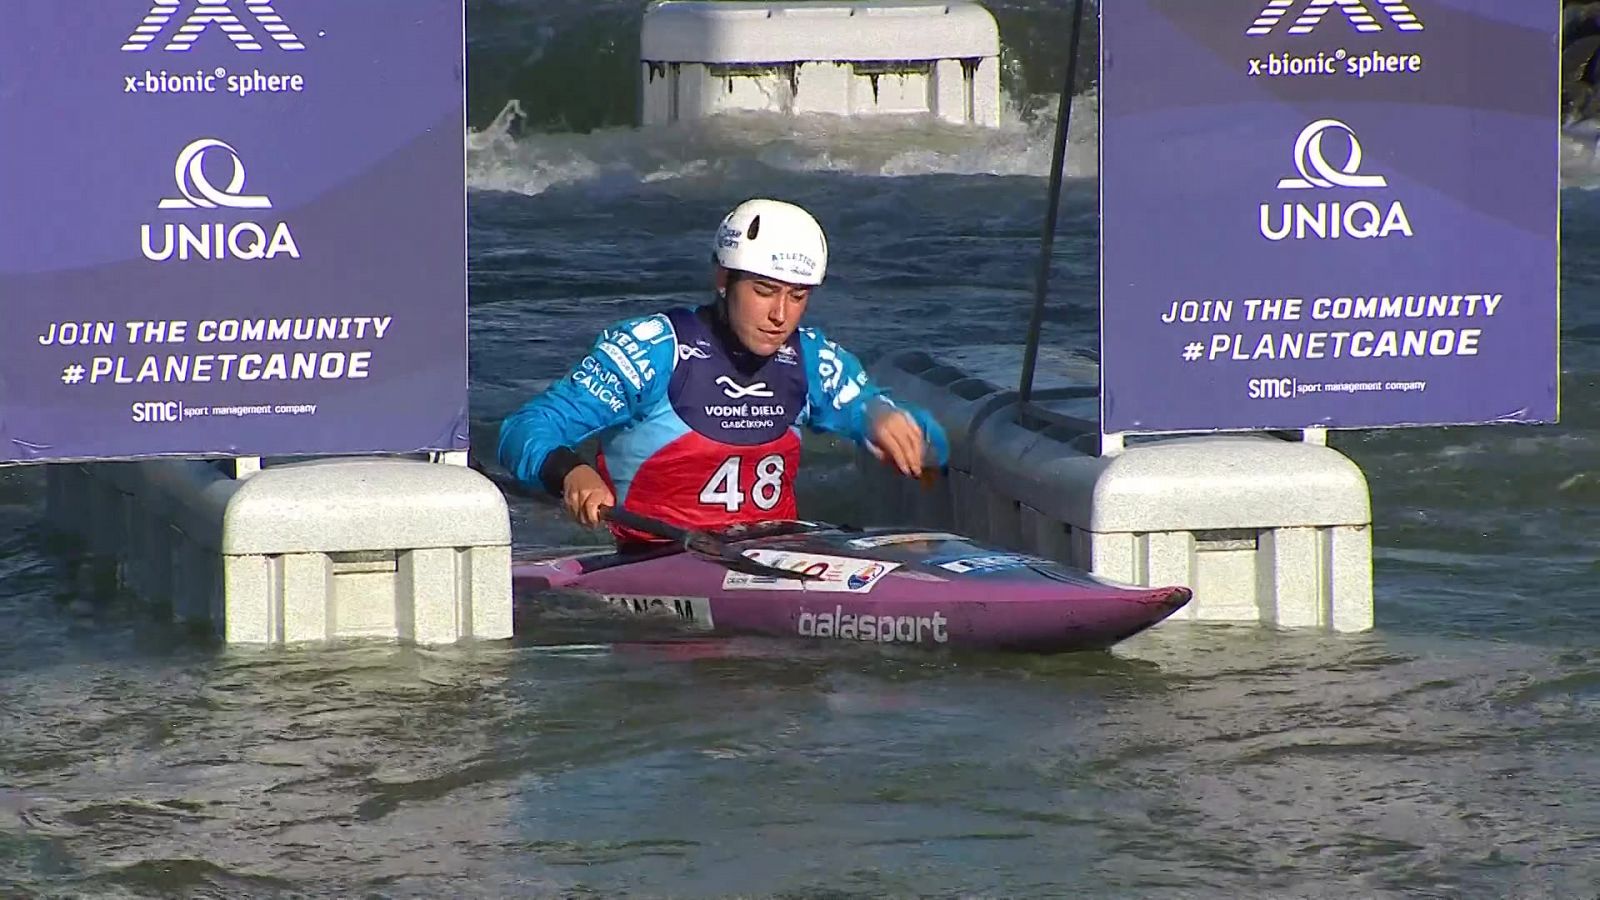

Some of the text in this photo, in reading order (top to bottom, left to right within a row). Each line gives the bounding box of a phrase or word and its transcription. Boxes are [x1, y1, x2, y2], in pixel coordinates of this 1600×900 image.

[1260, 200, 1413, 240] UNIQA
[140, 222, 300, 261] UNIQA
[1161, 294, 1503, 325] JOIN THE COMMUNITY
[38, 316, 392, 346] JOIN THE COMMUNITY
[1182, 329, 1482, 361] #PLANETCANOE
[61, 351, 372, 384] #PLANETCANOE
[1296, 383, 1322, 394] sport
[1325, 382, 1382, 394] management
[1385, 381, 1427, 393] company
[183, 406, 209, 418] sport
[212, 405, 272, 417] management
[274, 404, 317, 415] company
[704, 403, 785, 416] VODNÉ DIELO
[699, 454, 786, 513] 48
